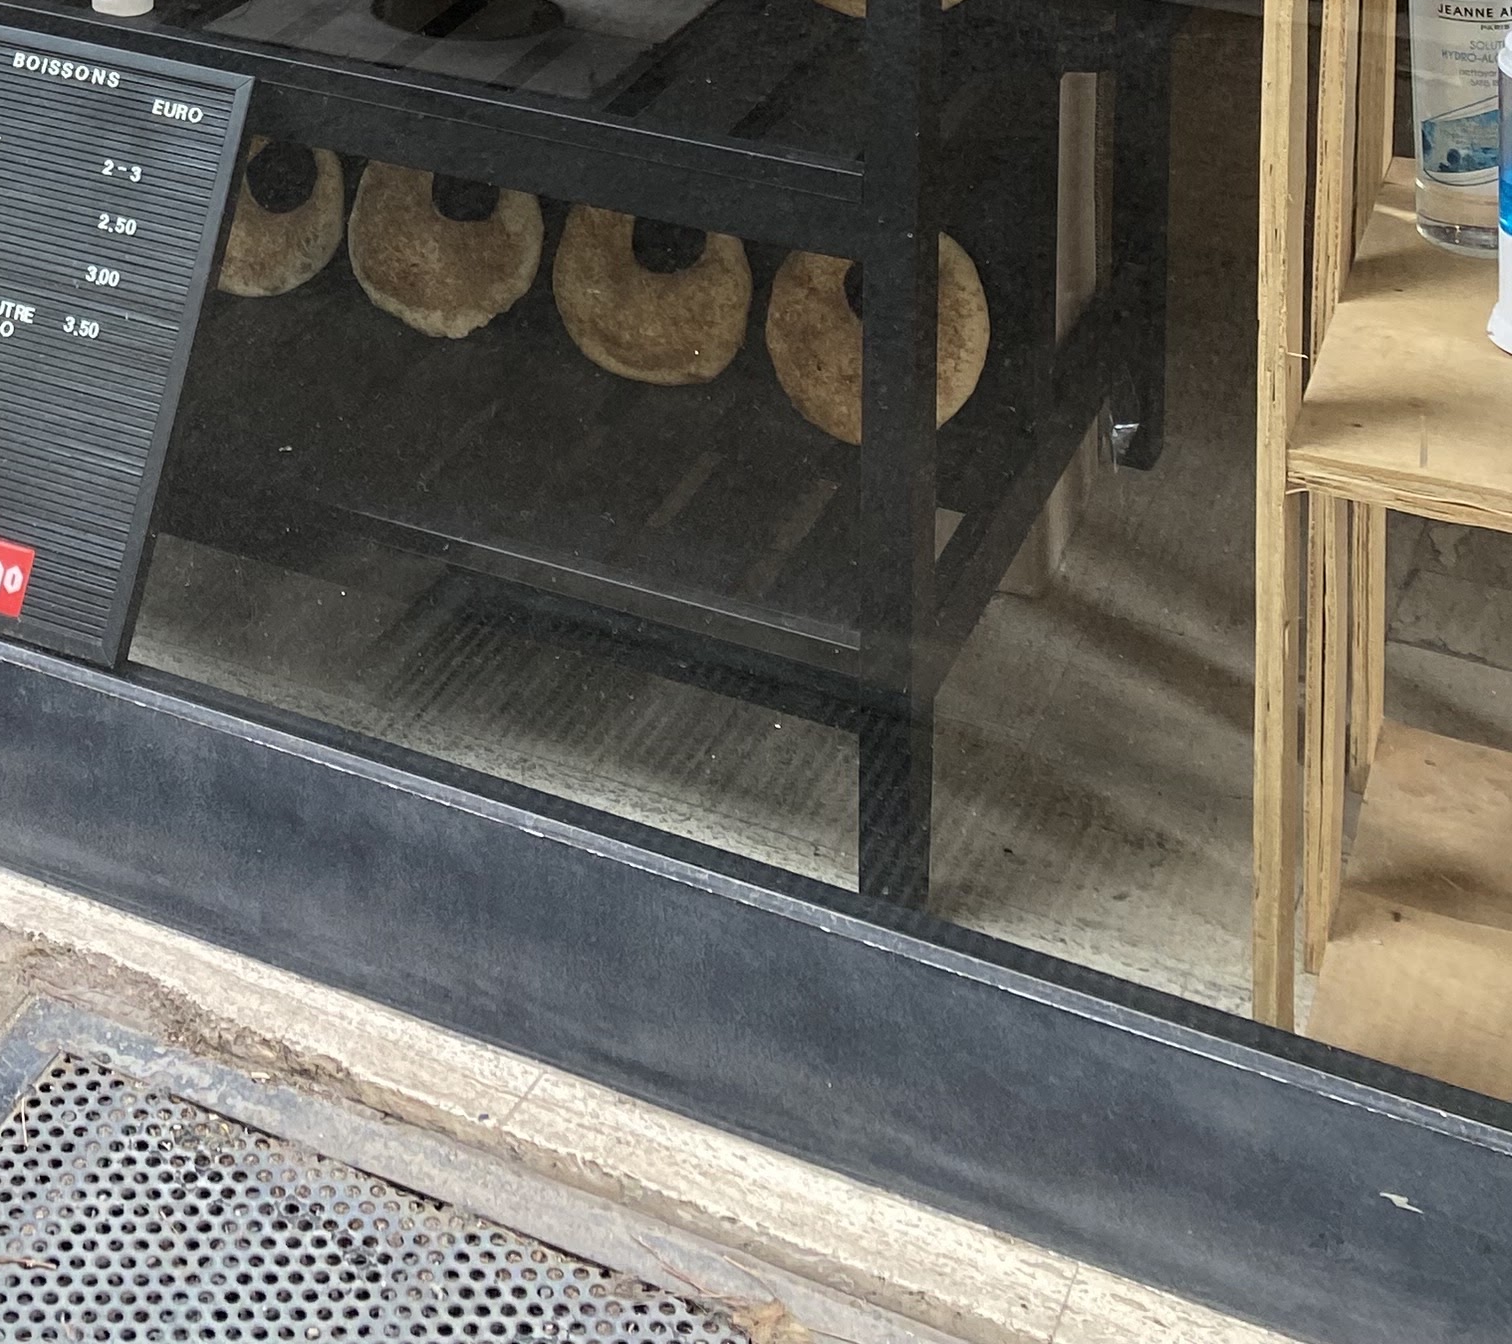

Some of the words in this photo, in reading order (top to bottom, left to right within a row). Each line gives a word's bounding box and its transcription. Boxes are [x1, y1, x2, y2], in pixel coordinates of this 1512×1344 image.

[1437, 3, 1494, 18] JEANNE
[11, 51, 121, 89] BOISSONS
[151, 98, 204, 124] EURO
[101, 159, 143, 183] 2-3
[97, 213, 138, 236] 2.50
[85, 265, 121, 288] 3.00
[62, 316, 101, 340] 3.50
